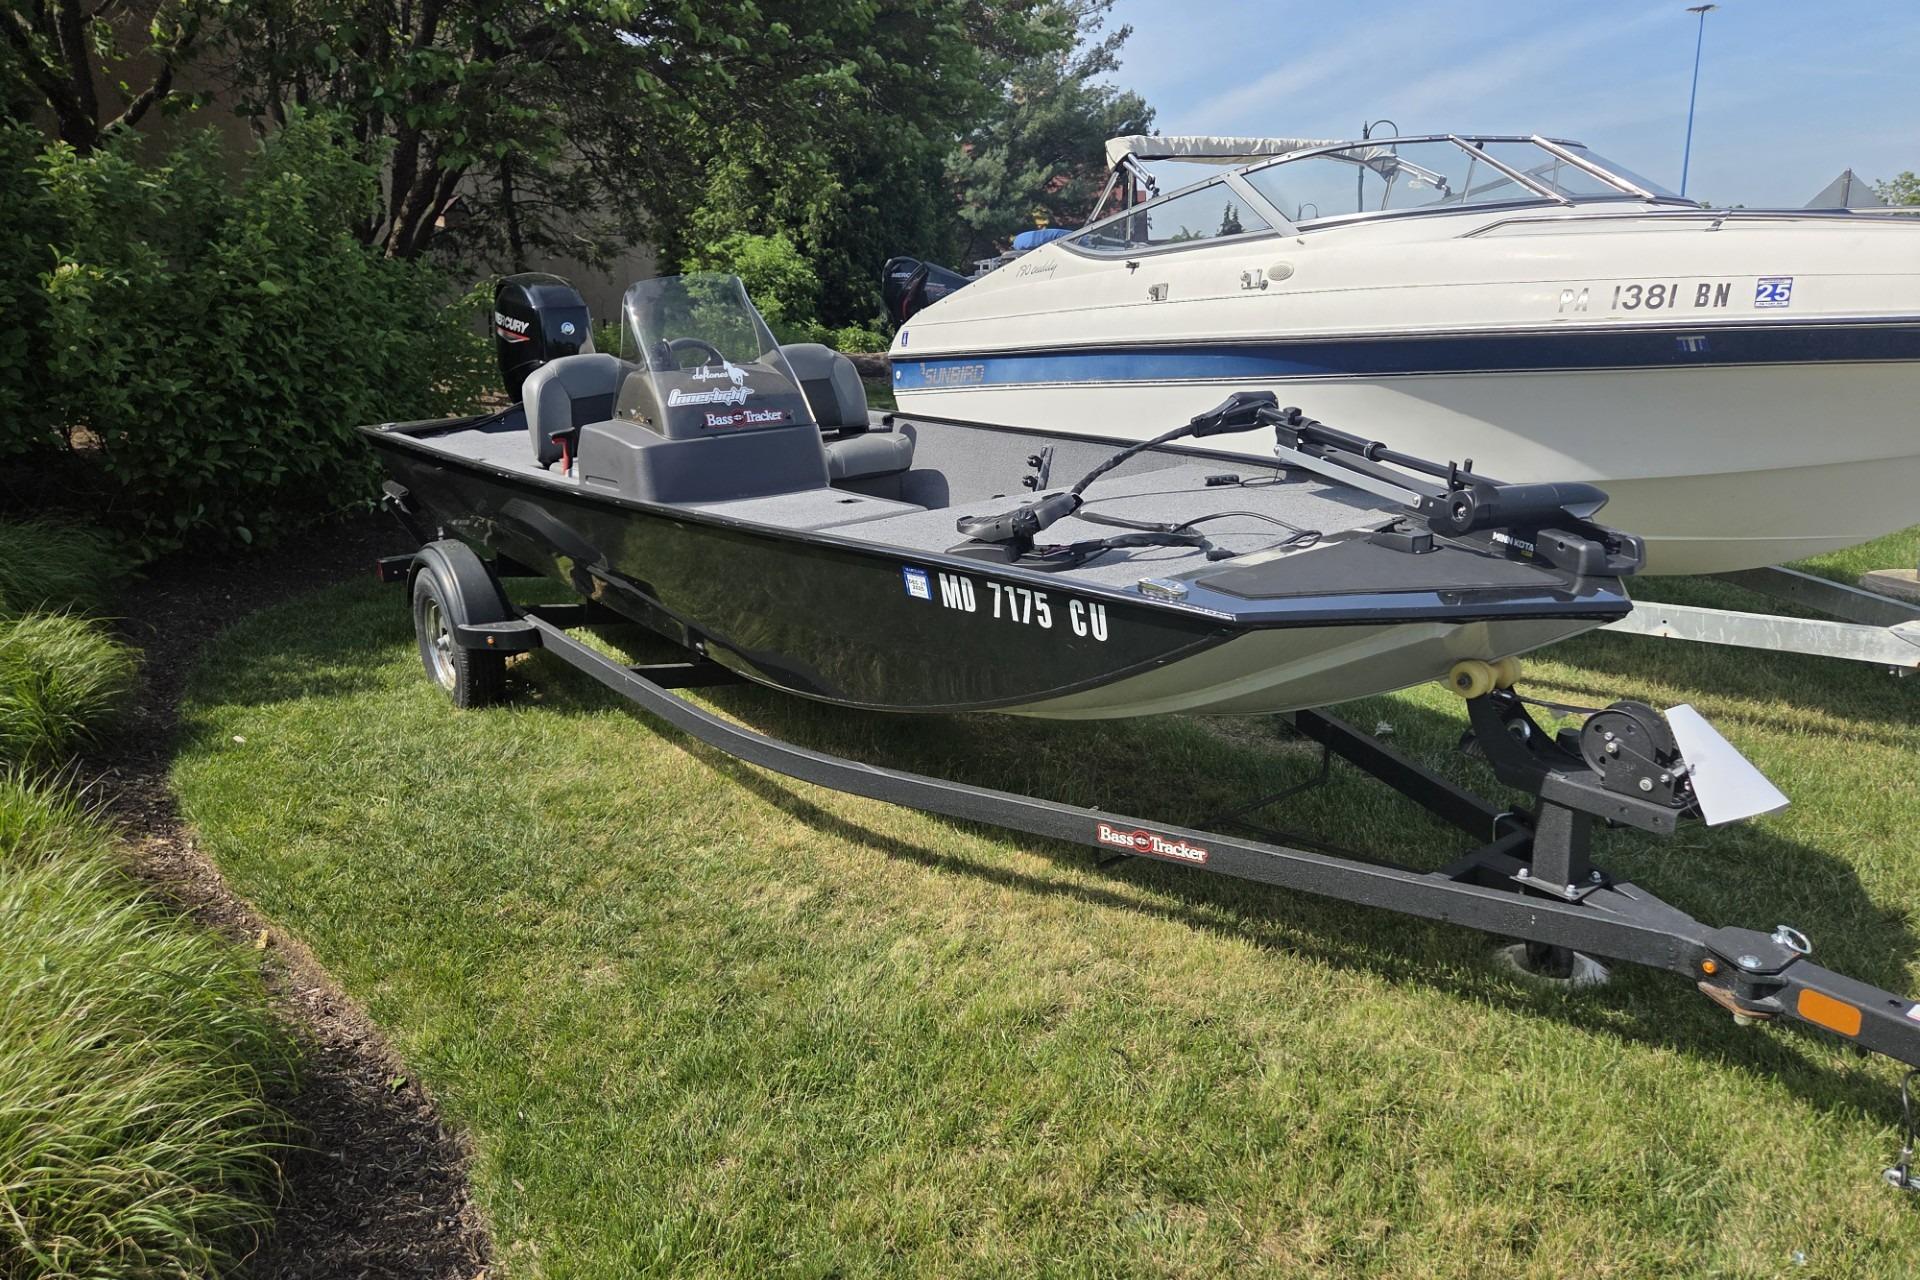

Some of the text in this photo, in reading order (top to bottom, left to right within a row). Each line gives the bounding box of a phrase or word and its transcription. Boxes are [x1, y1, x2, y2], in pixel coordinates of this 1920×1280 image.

[1558, 283, 1731, 313] PA 1381 BN
[1756, 284, 1791, 301] 25
[692, 366, 728, 382] deftones
[925, 365, 984, 384] SUNBIRD
[705, 410, 782, 426] Bass Tracker
[938, 572, 1108, 641] MD 7175 CU
[1099, 826, 1206, 861] Bass Tracker
